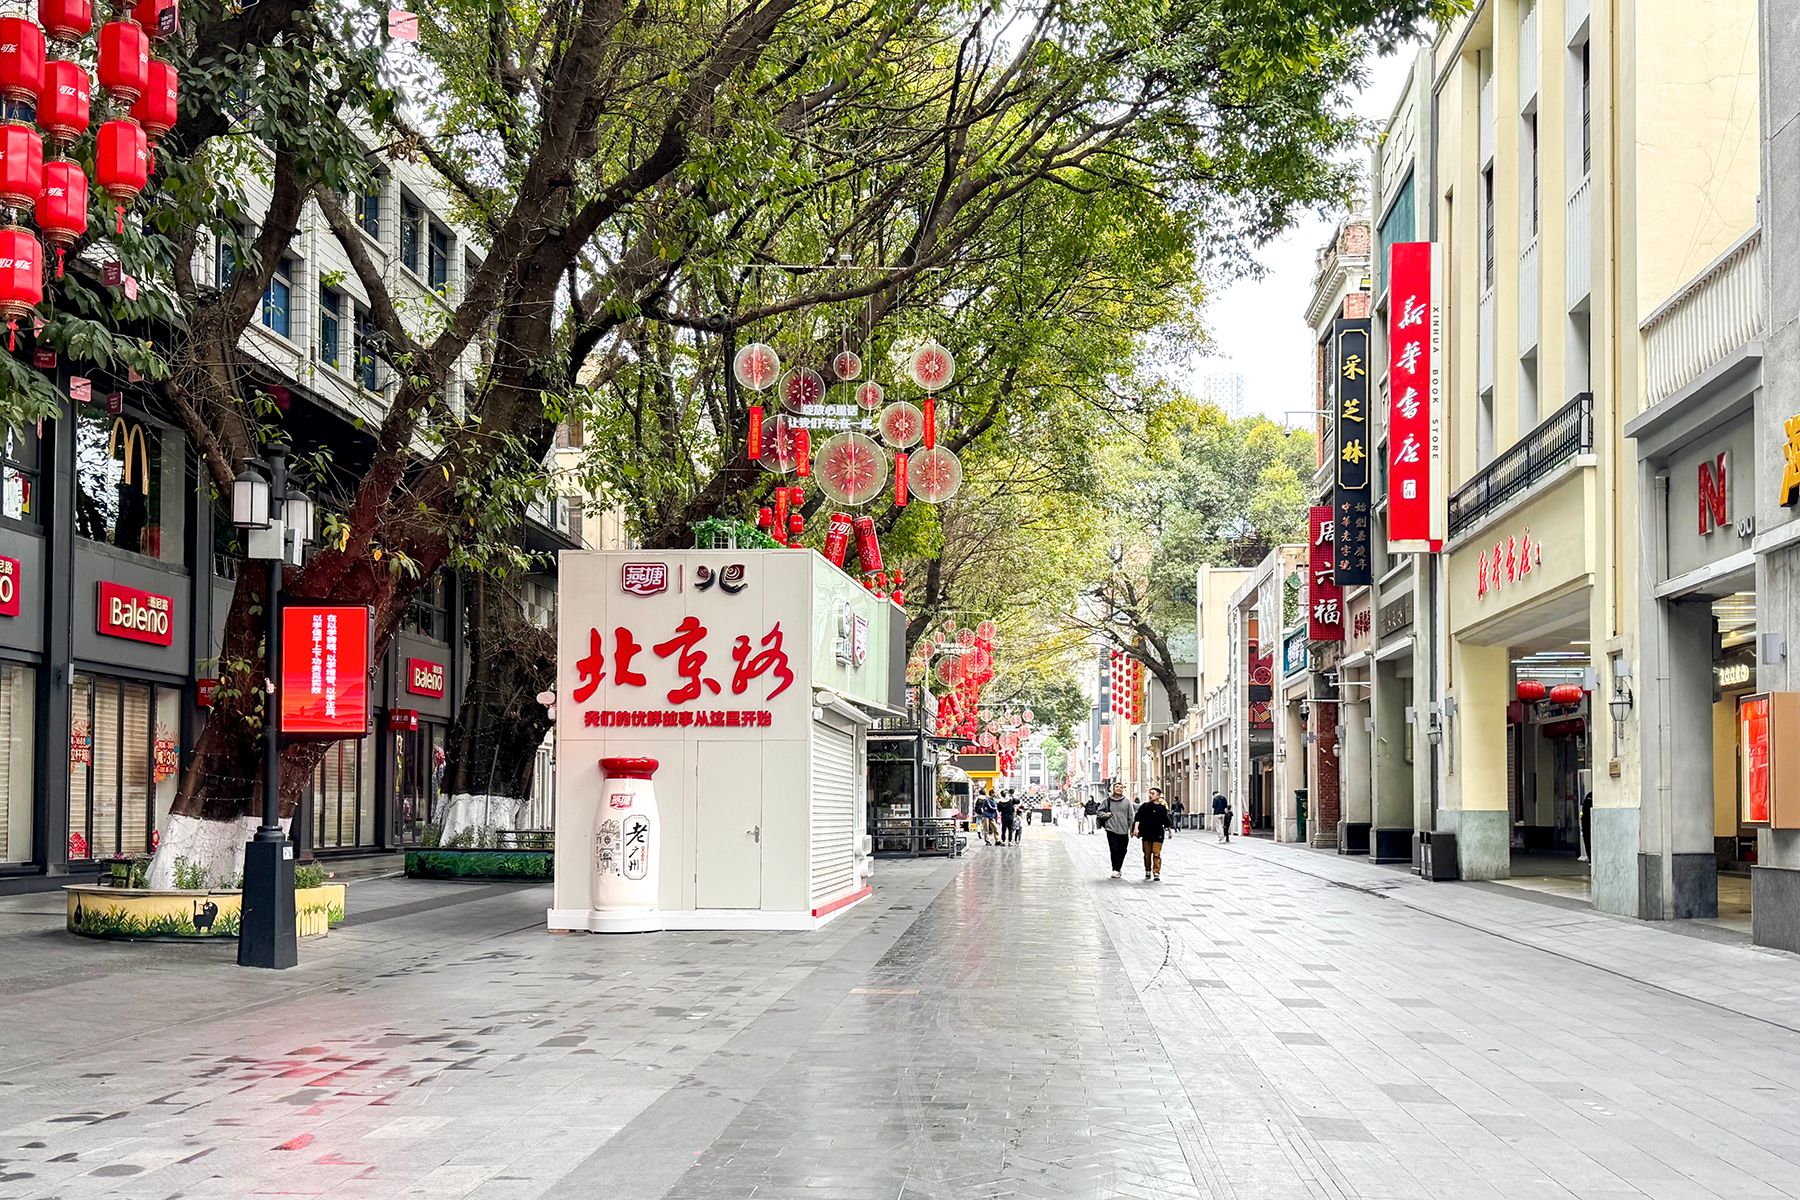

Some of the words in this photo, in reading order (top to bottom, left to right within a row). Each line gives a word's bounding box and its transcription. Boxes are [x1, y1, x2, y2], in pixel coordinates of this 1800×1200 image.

[1342, 354, 1366, 465] 采芝林
[626, 567, 663, 585] 燕塘
[110, 597, 169, 635] Baleno
[414, 667, 443, 691] Baleno
[573, 615, 795, 705] 北京路
[626, 822, 648, 871] 老广州
